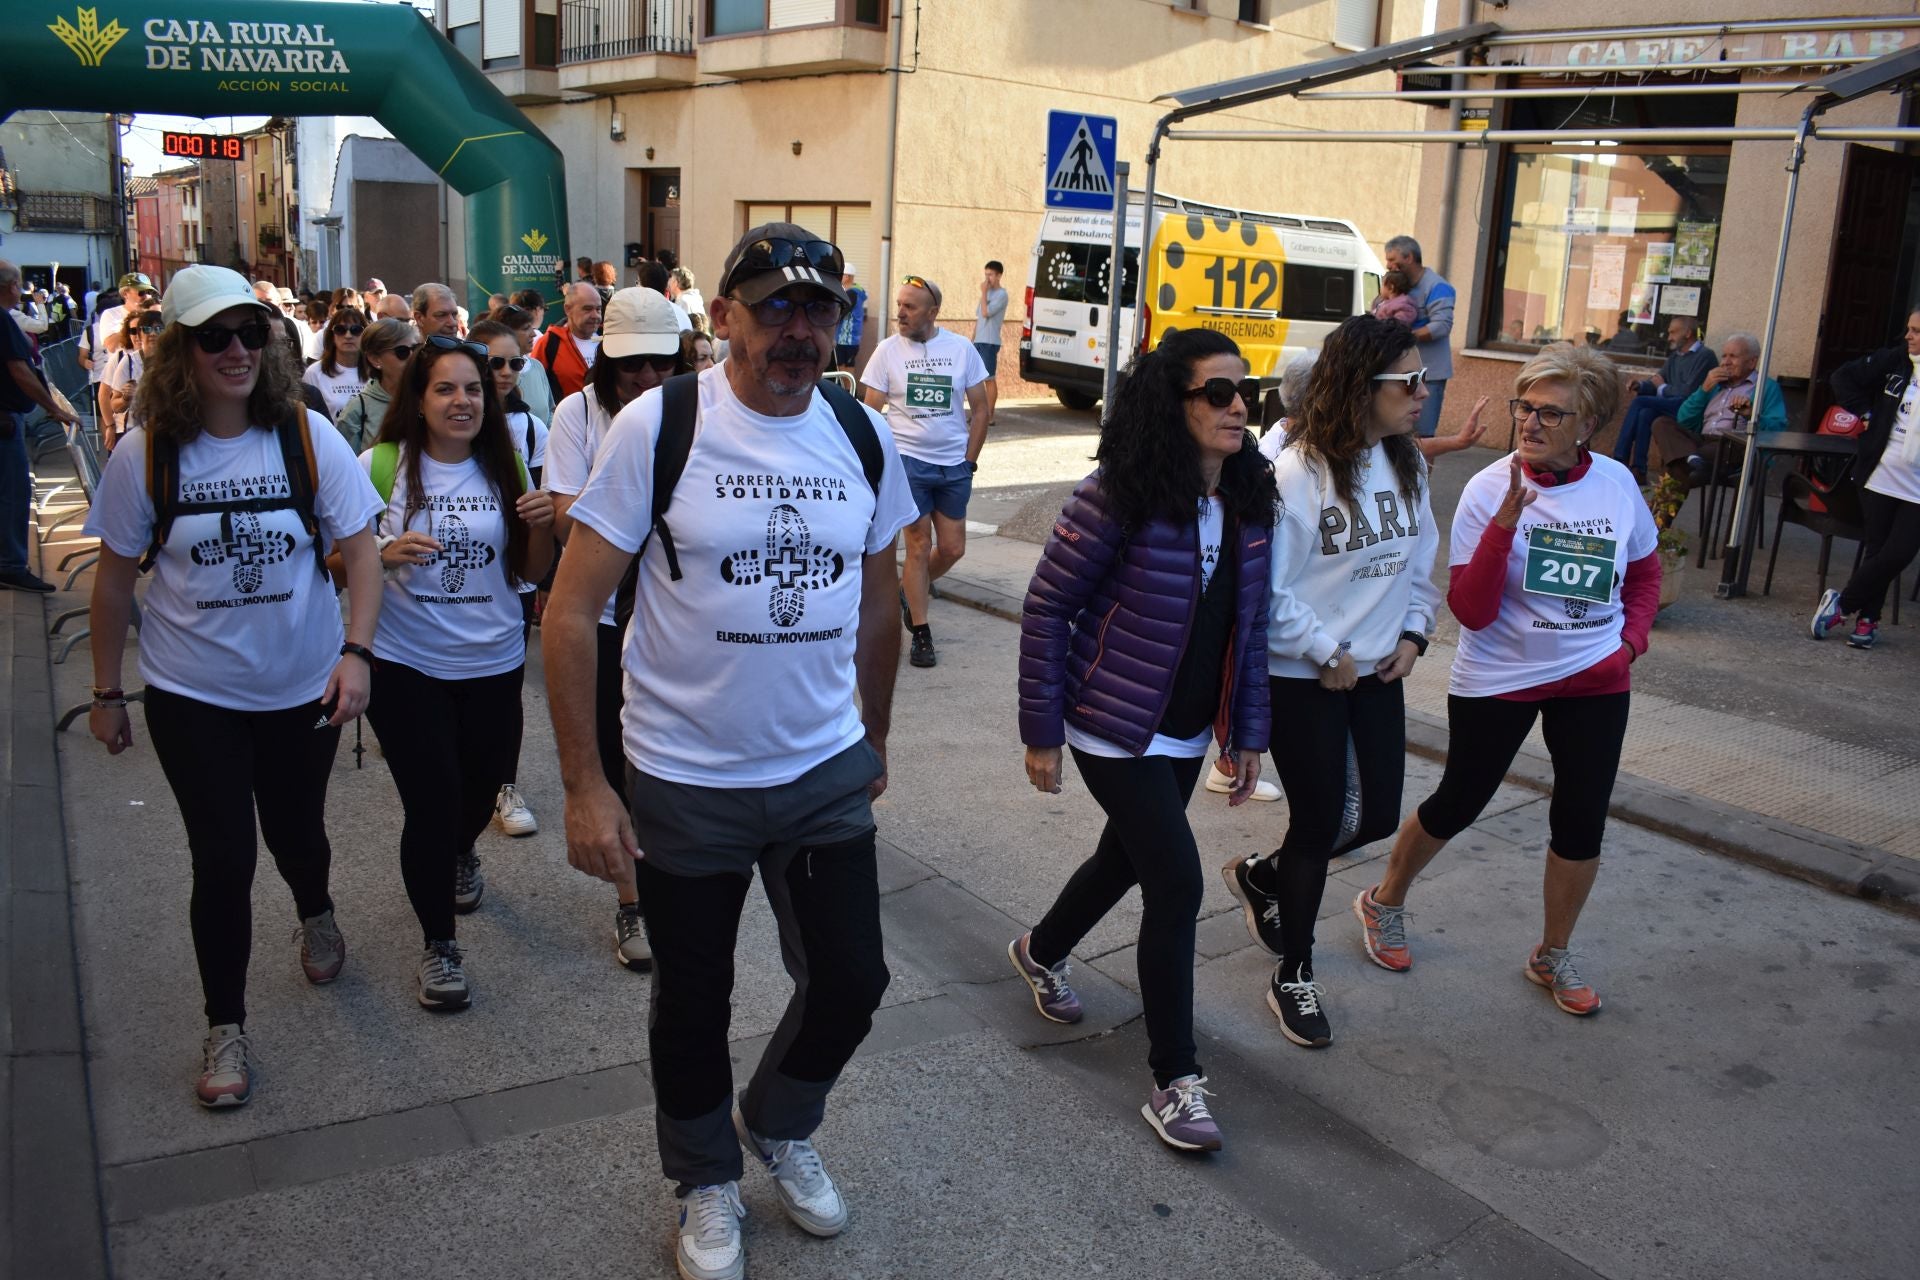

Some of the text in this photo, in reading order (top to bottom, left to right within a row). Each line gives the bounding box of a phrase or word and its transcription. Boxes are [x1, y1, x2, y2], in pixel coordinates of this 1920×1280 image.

[144, 19, 334, 46] CAJA RURAL
[1567, 37, 1705, 67] CAFE
[1781, 31, 1905, 60] BAR
[146, 45, 350, 73] DE NAVARRA
[217, 79, 349, 92] ACCIÓN SOCIAL
[1064, 229, 1112, 239] ambulanc
[503, 254, 531, 265] CAJA
[501, 264, 556, 275] DE NAVAR
[1058, 262, 1075, 276] 112
[1204, 256, 1278, 319] 112
[1201, 320, 1276, 338] EMERGENCIAS
[913, 388, 945, 403] 326
[182, 474, 288, 493] CARRERA-MARCHA
[715, 474, 846, 488] CARRERA-MARCHA
[184, 484, 288, 503] SOLIDARIA
[716, 487, 848, 502] SOLIDARIA
[1319, 490, 1419, 555] PARI
[1540, 559, 1602, 588] 207
